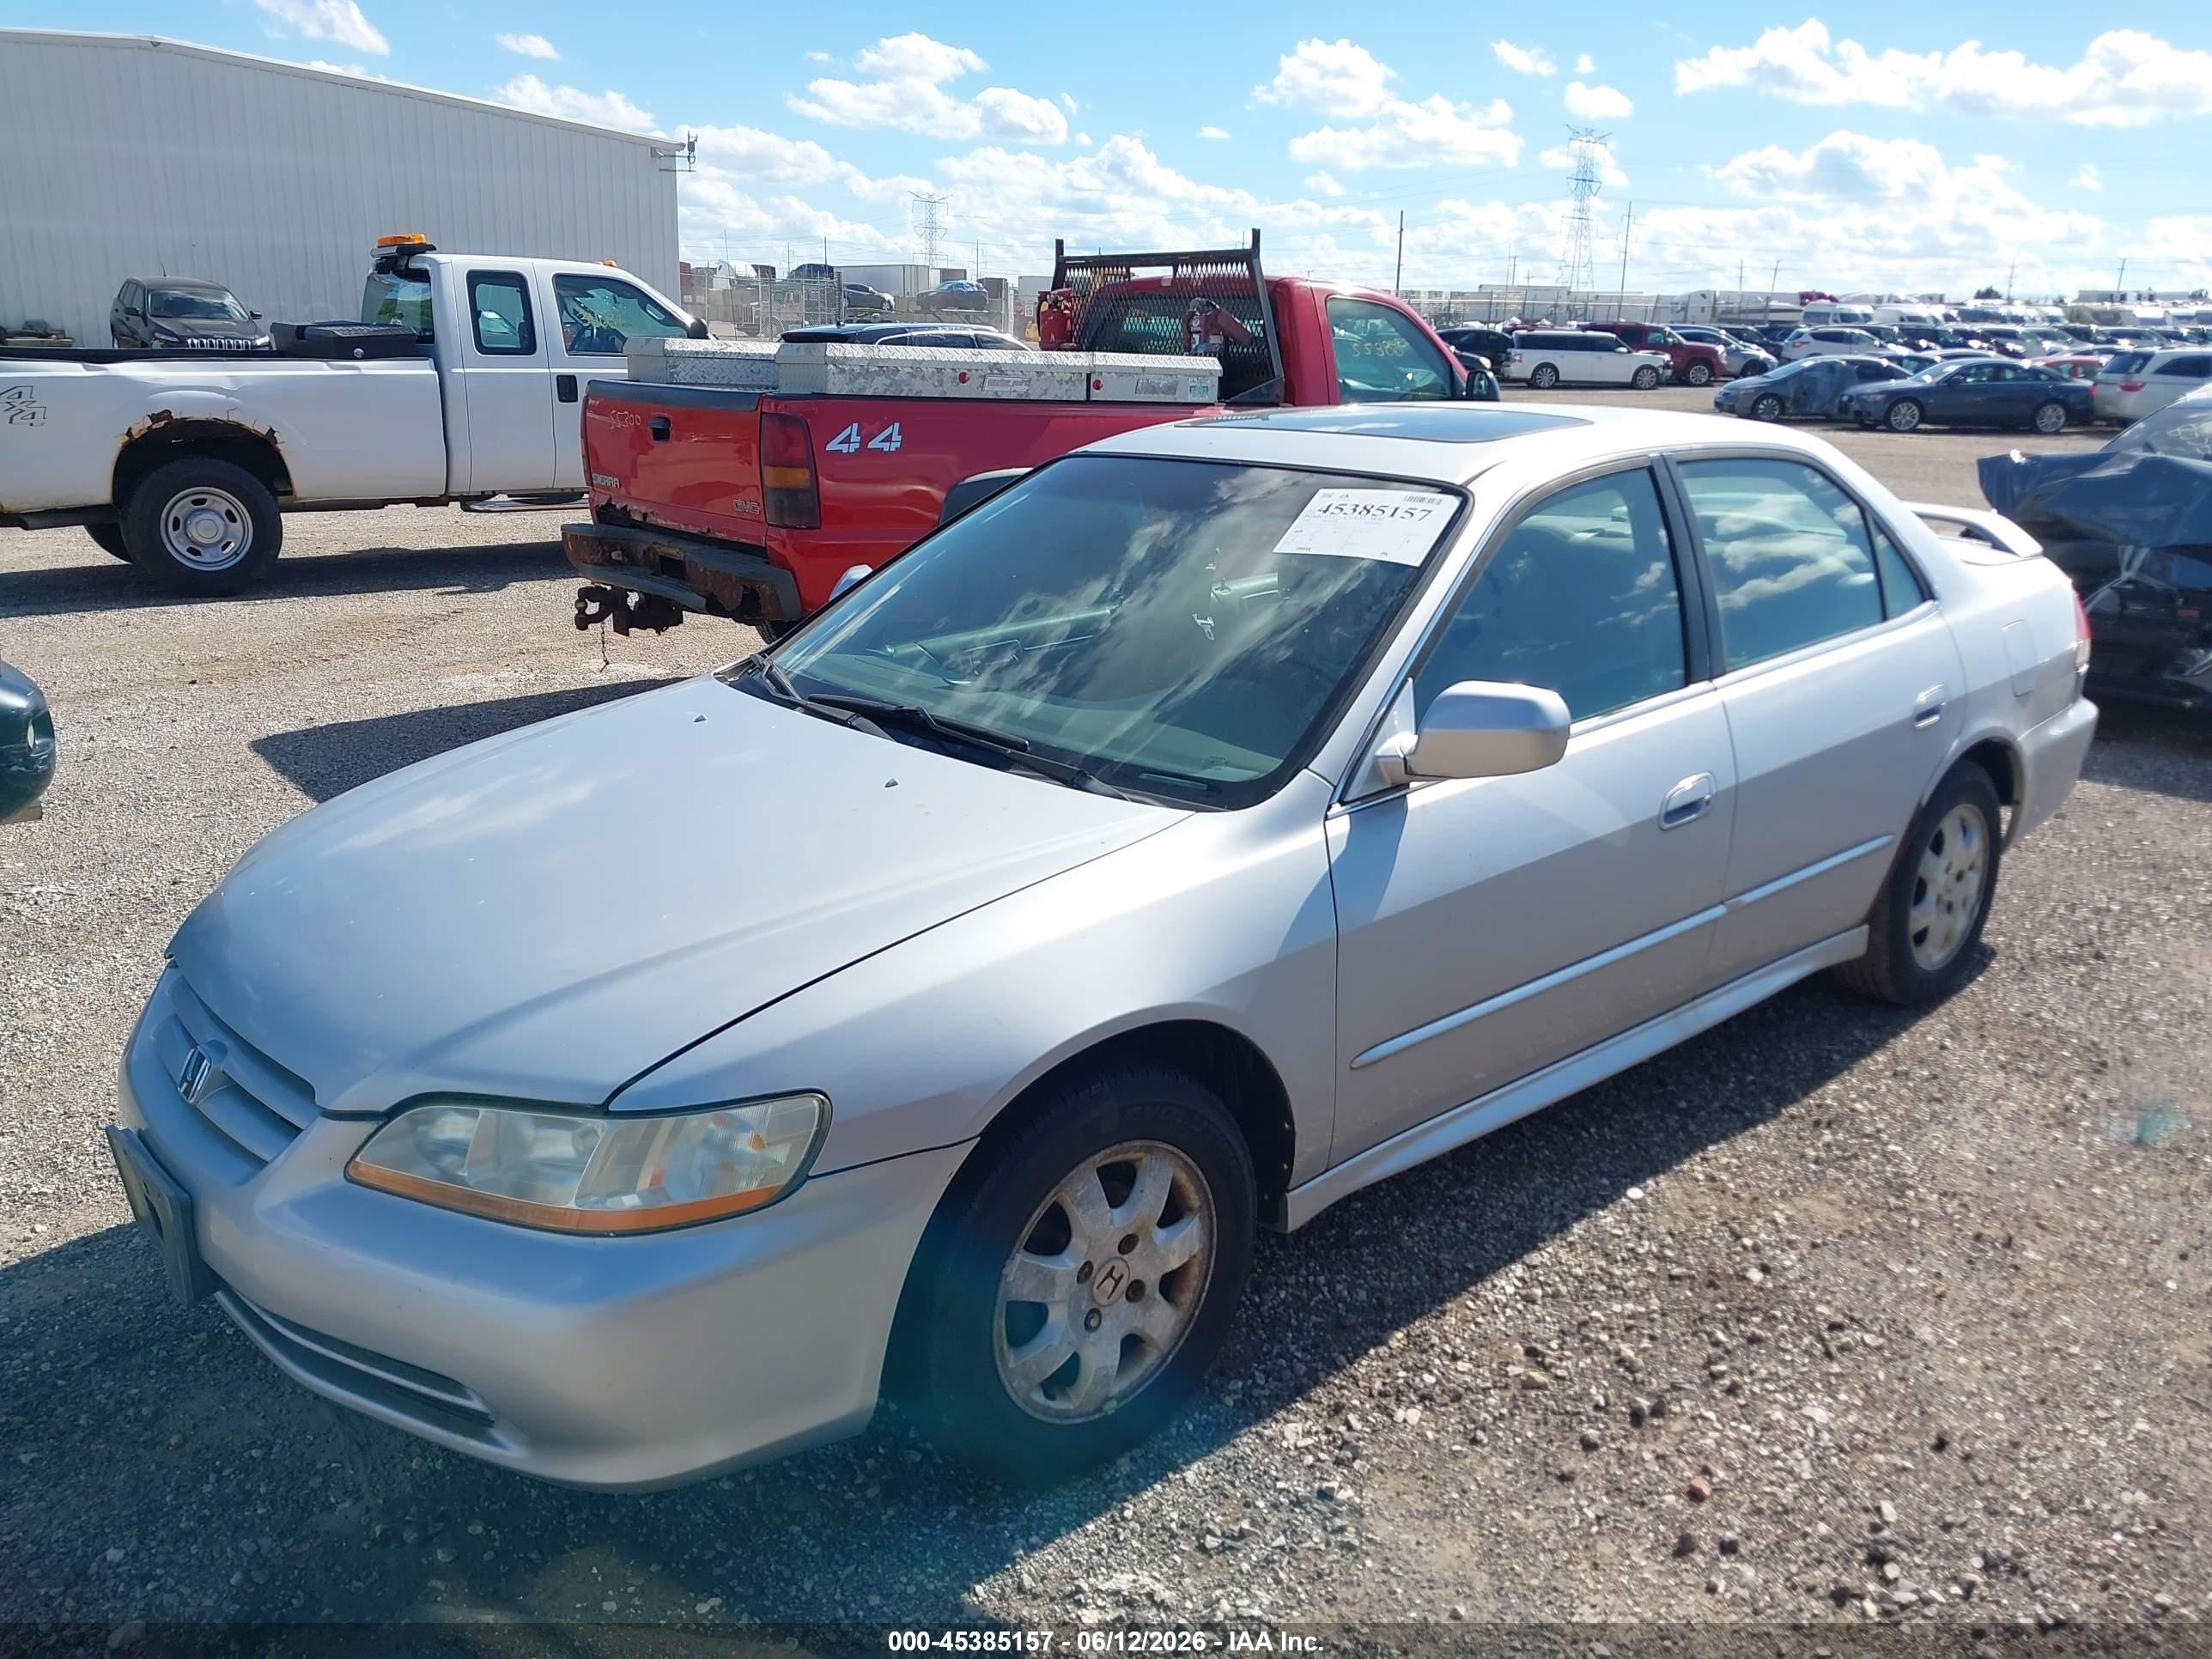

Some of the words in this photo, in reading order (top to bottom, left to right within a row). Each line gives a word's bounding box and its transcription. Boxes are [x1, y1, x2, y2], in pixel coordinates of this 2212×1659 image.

[610, 410, 641, 429] 55300
[592, 473, 620, 488] SIERRA
[733, 499, 760, 514] GMC
[1317, 502, 1433, 521] 45385157
